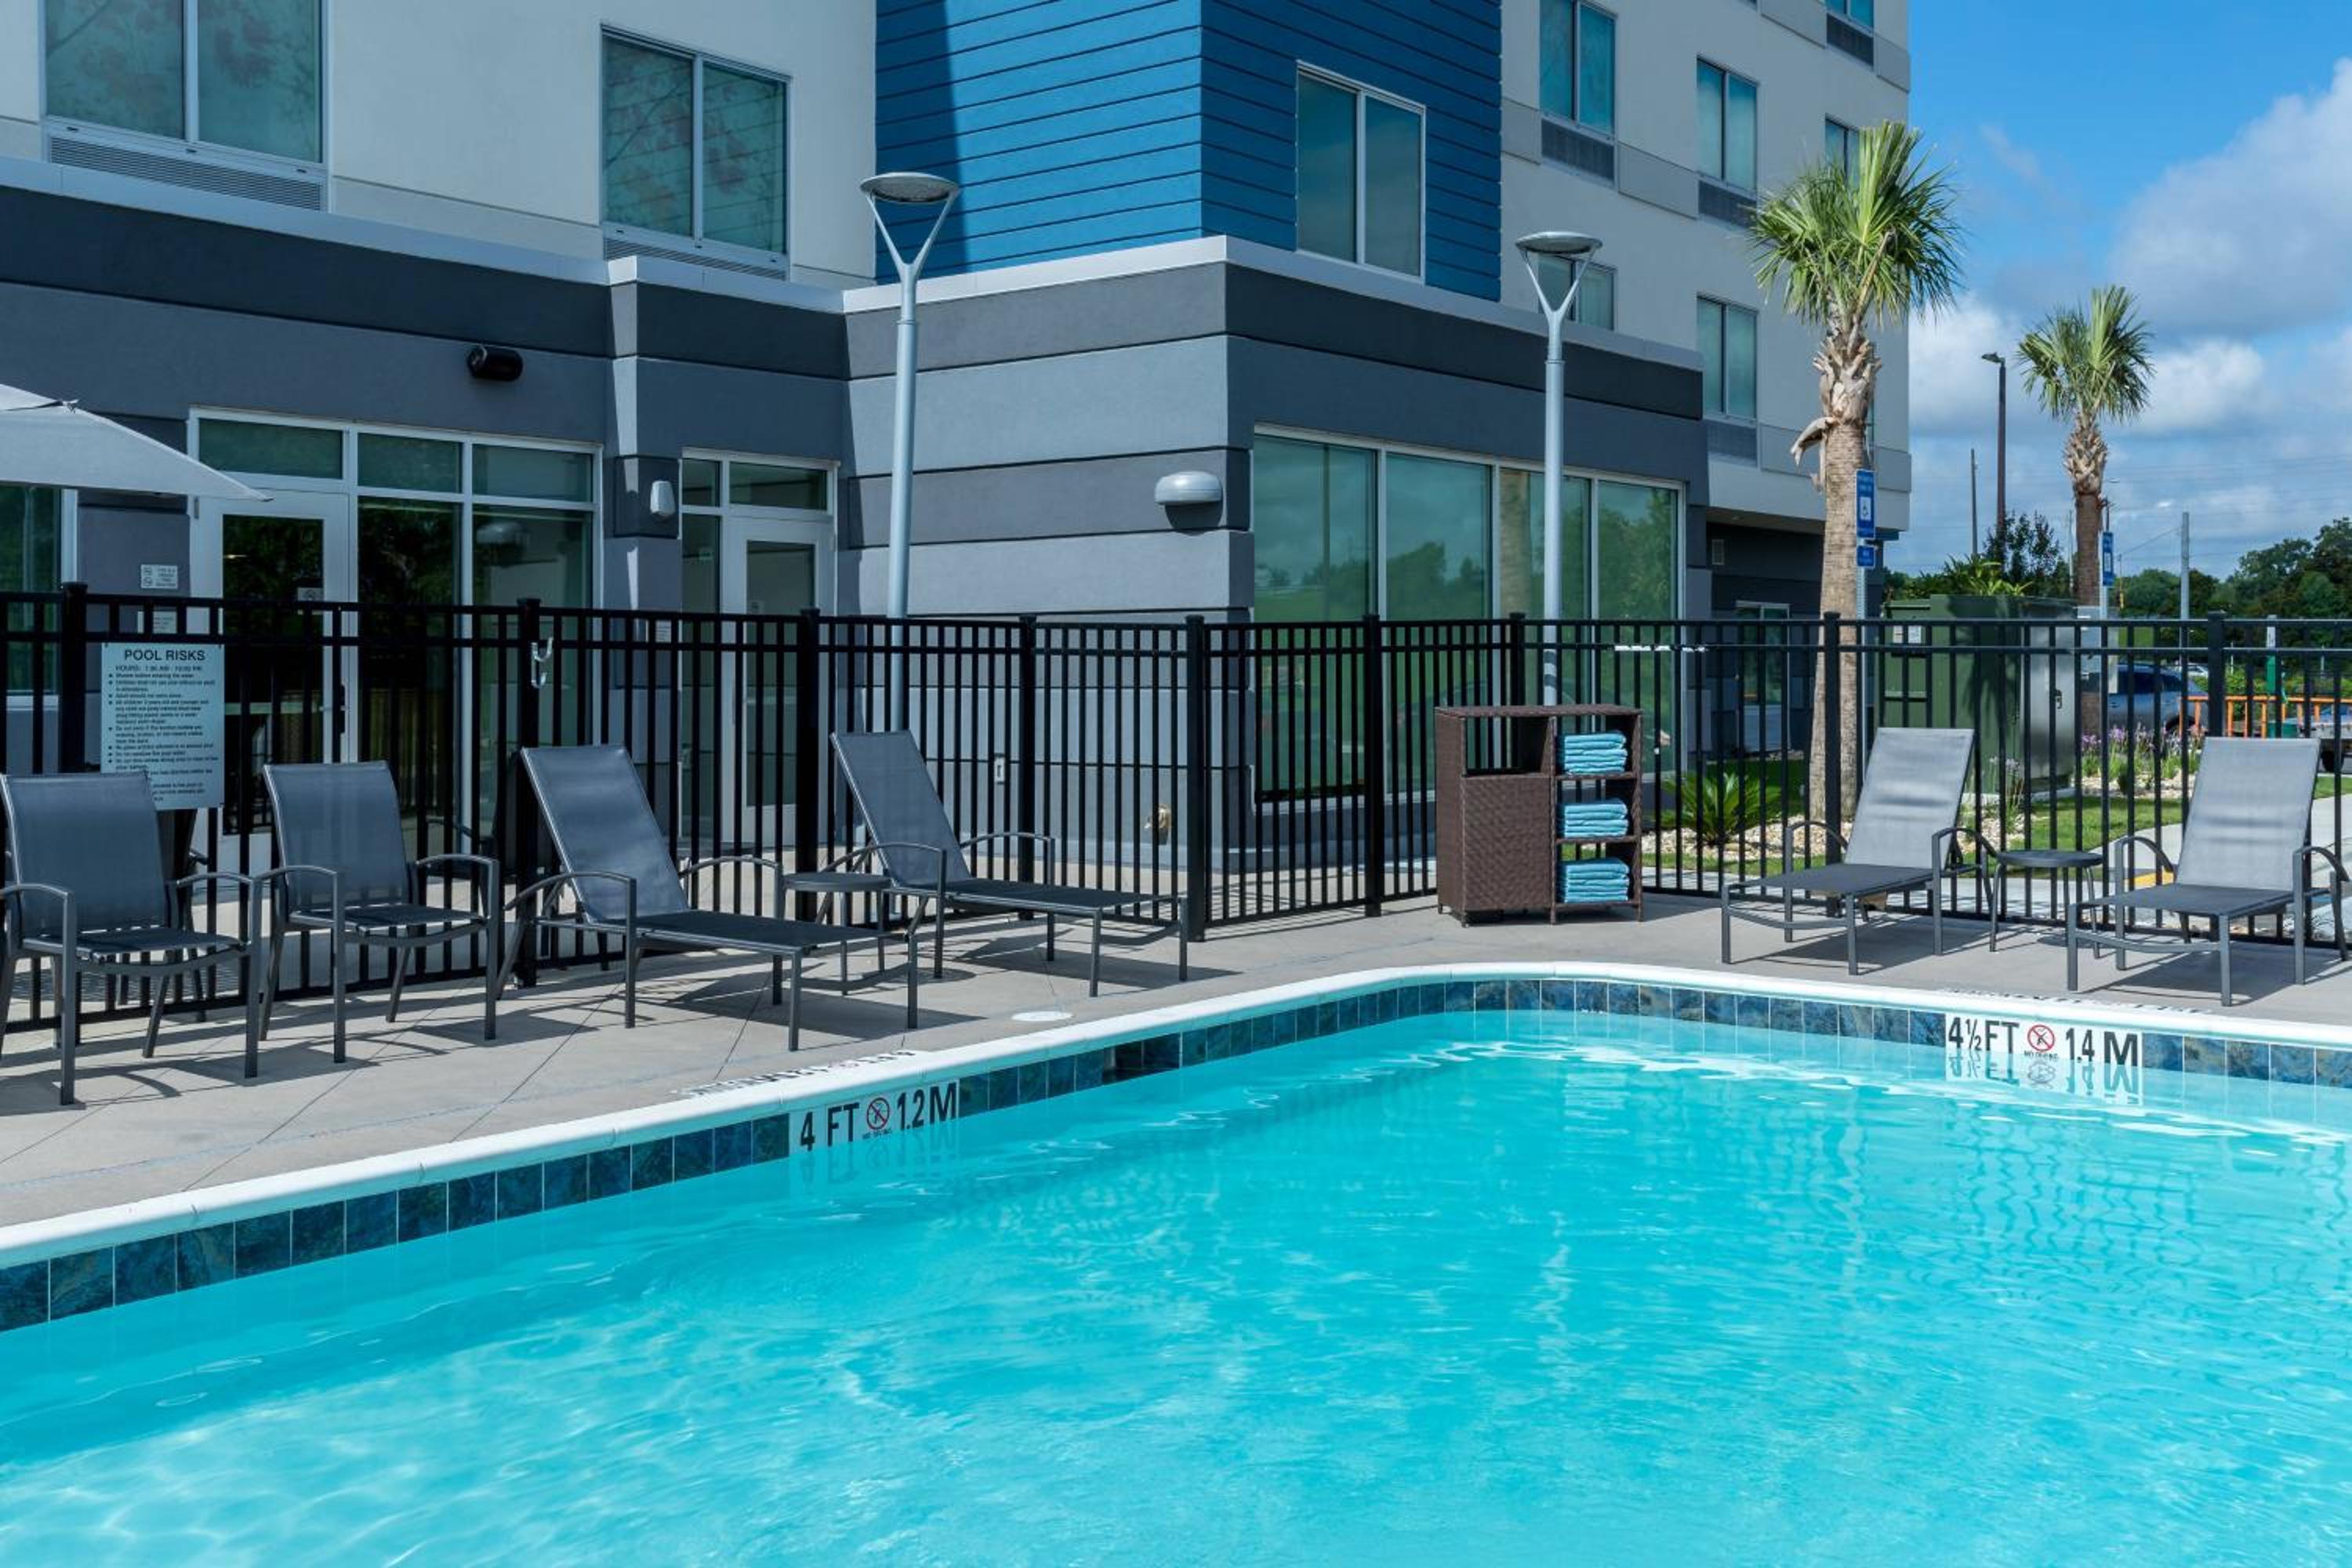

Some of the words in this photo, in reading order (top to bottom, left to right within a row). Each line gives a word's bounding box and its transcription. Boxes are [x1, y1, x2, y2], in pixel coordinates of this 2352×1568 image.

[125, 650, 162, 661] POOL
[165, 650, 205, 661] RISKS
[1985, 1020, 2020, 1054] FT
[2103, 1031, 2138, 1066] M
[800, 1111, 816, 1152] 4
[828, 1102, 860, 1147] FT
